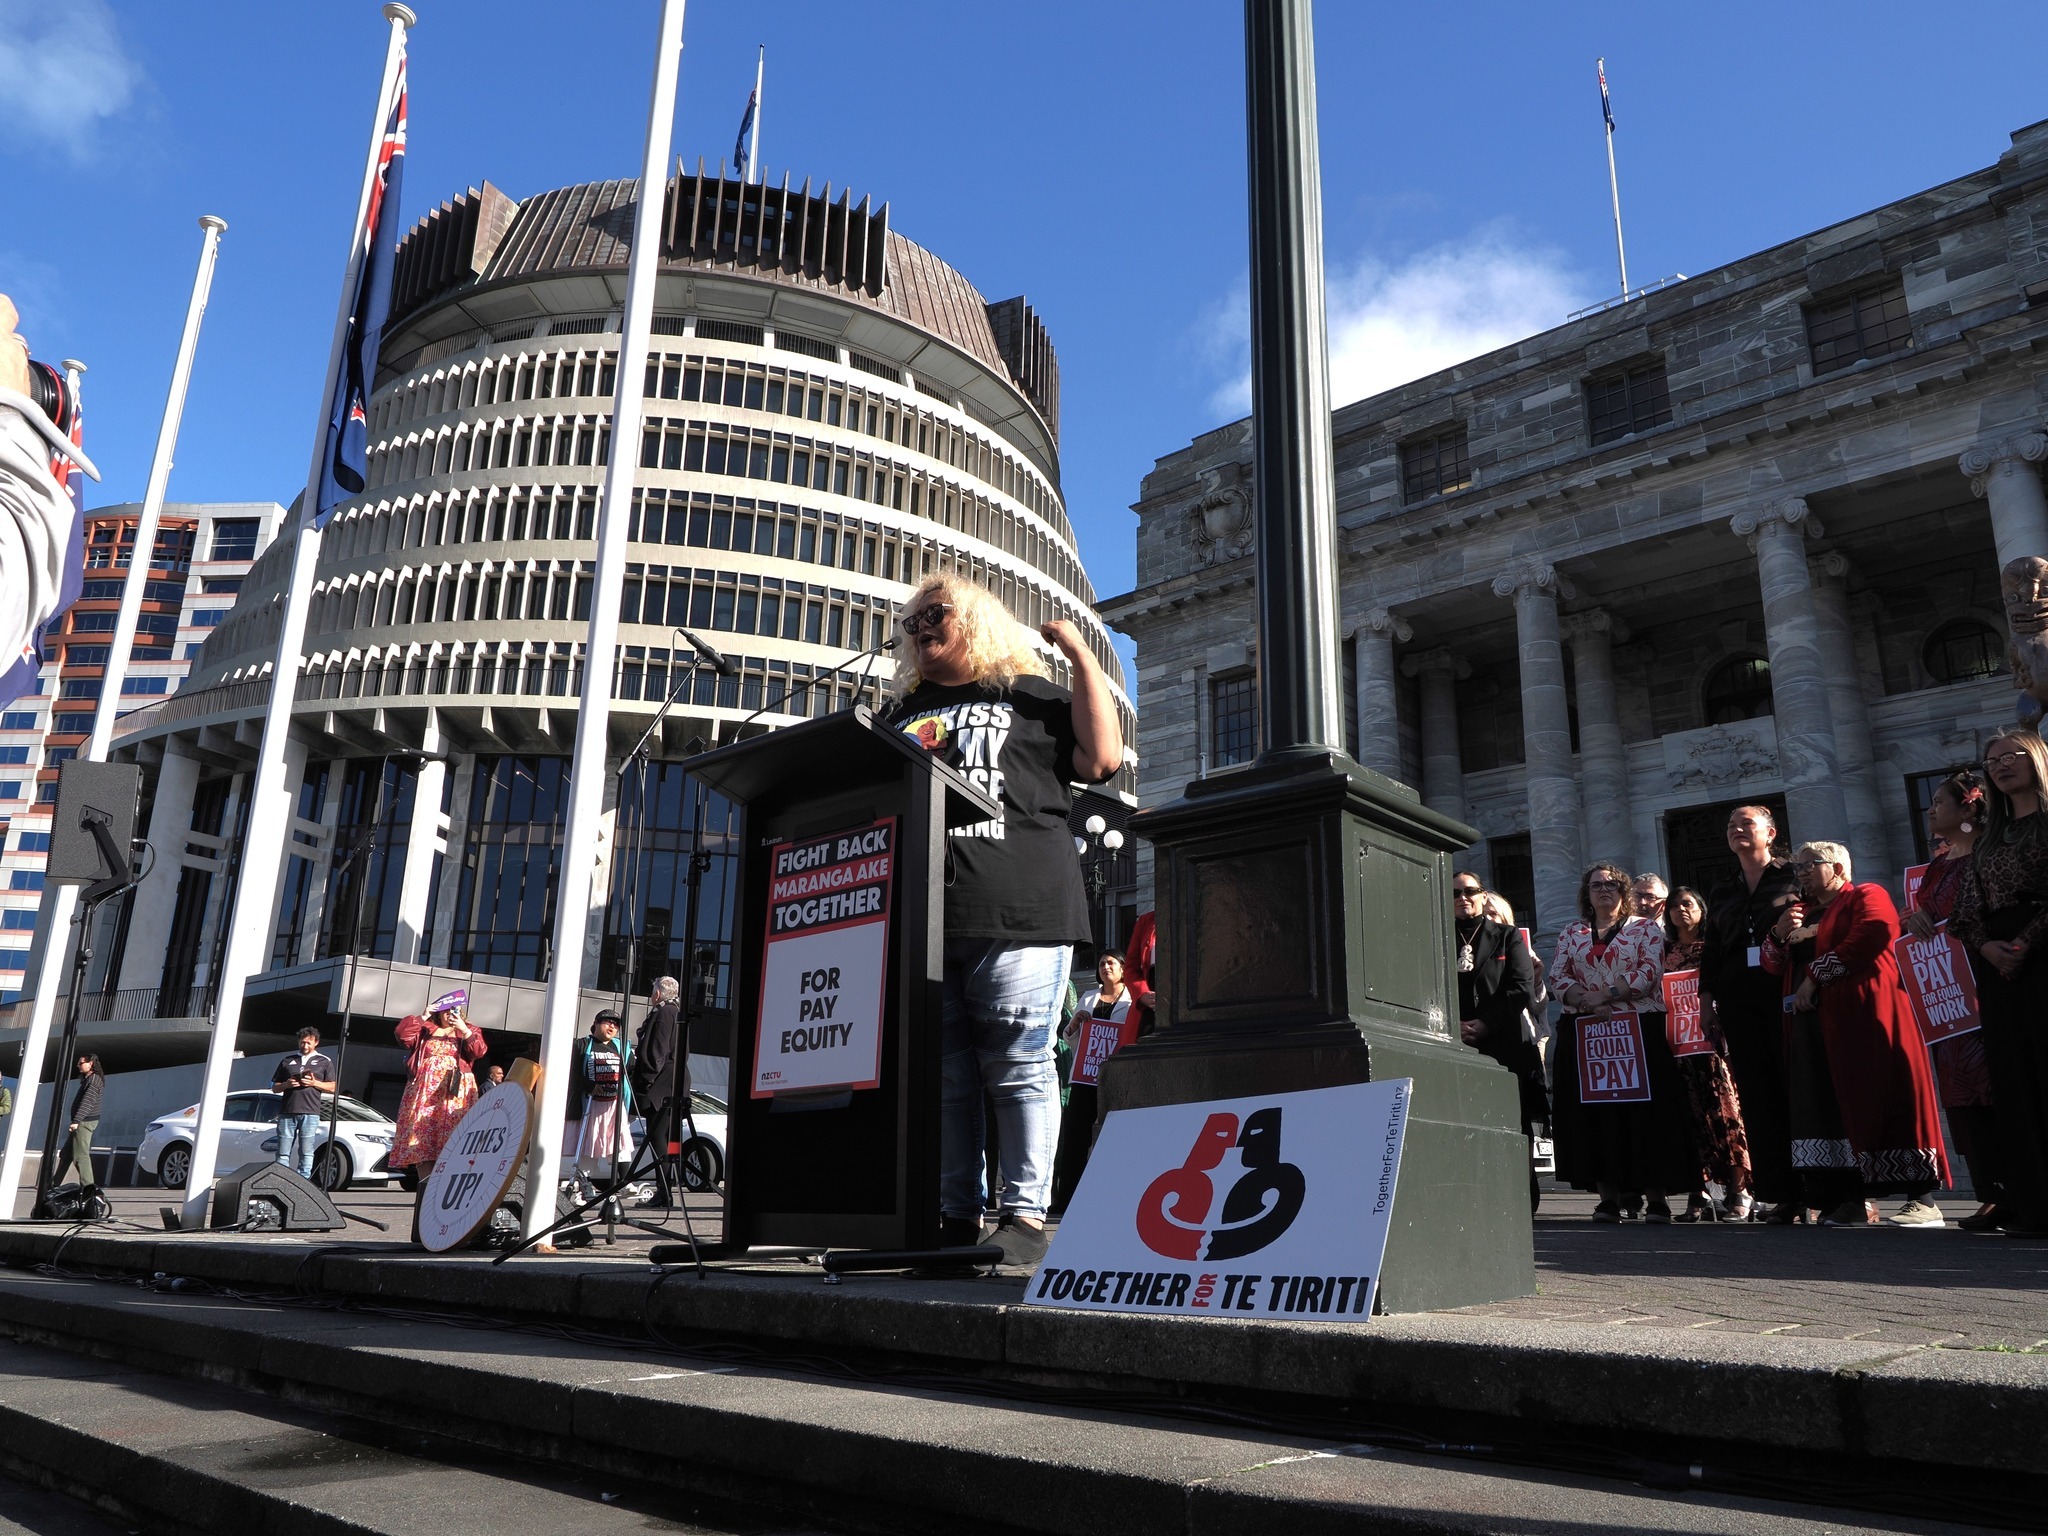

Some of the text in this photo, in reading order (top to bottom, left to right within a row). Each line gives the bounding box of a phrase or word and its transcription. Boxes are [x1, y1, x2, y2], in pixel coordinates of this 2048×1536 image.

[917, 709, 940, 719] CAN
[939, 702, 1013, 731] KISS
[957, 727, 1009, 768] MY
[778, 829, 887, 874] FIGHT BACK
[774, 857, 888, 899] MARANGA AKE
[776, 887, 881, 930] TOGETHER
[1907, 932, 1950, 964] EQUAL
[800, 967, 840, 994] FOR
[1913, 951, 1956, 994] PAY
[1670, 979, 1699, 994] PROT
[1922, 983, 1964, 1007] FOR EQUAL
[799, 995, 838, 1022] PAY
[1674, 996, 1699, 1014] EQU
[1925, 996, 1971, 1027] WORK
[780, 1022, 853, 1053] EQUITY
[1090, 1024, 1118, 1040] EQUAL
[1585, 1020, 1631, 1038] PROTECT
[1676, 1014, 1705, 1043] PA
[1084, 1056, 1096, 1064] FOR
[1087, 1037, 1118, 1057] PAY
[1587, 1037, 1634, 1059] EQUAL
[1082, 1064, 1099, 1077] WO
[1590, 1058, 1635, 1090] PAY
[493, 1098, 504, 1110] 60
[1373, 1086, 1404, 1215] TogetherForTeTiriti.nz
[435, 1161, 446, 1174] 45
[497, 1160, 507, 1172] 15
[441, 1172, 484, 1210] UP!
[438, 1224, 448, 1236] 30
[1036, 1268, 1370, 1314] TOGETHER FOR TE TIRITI
